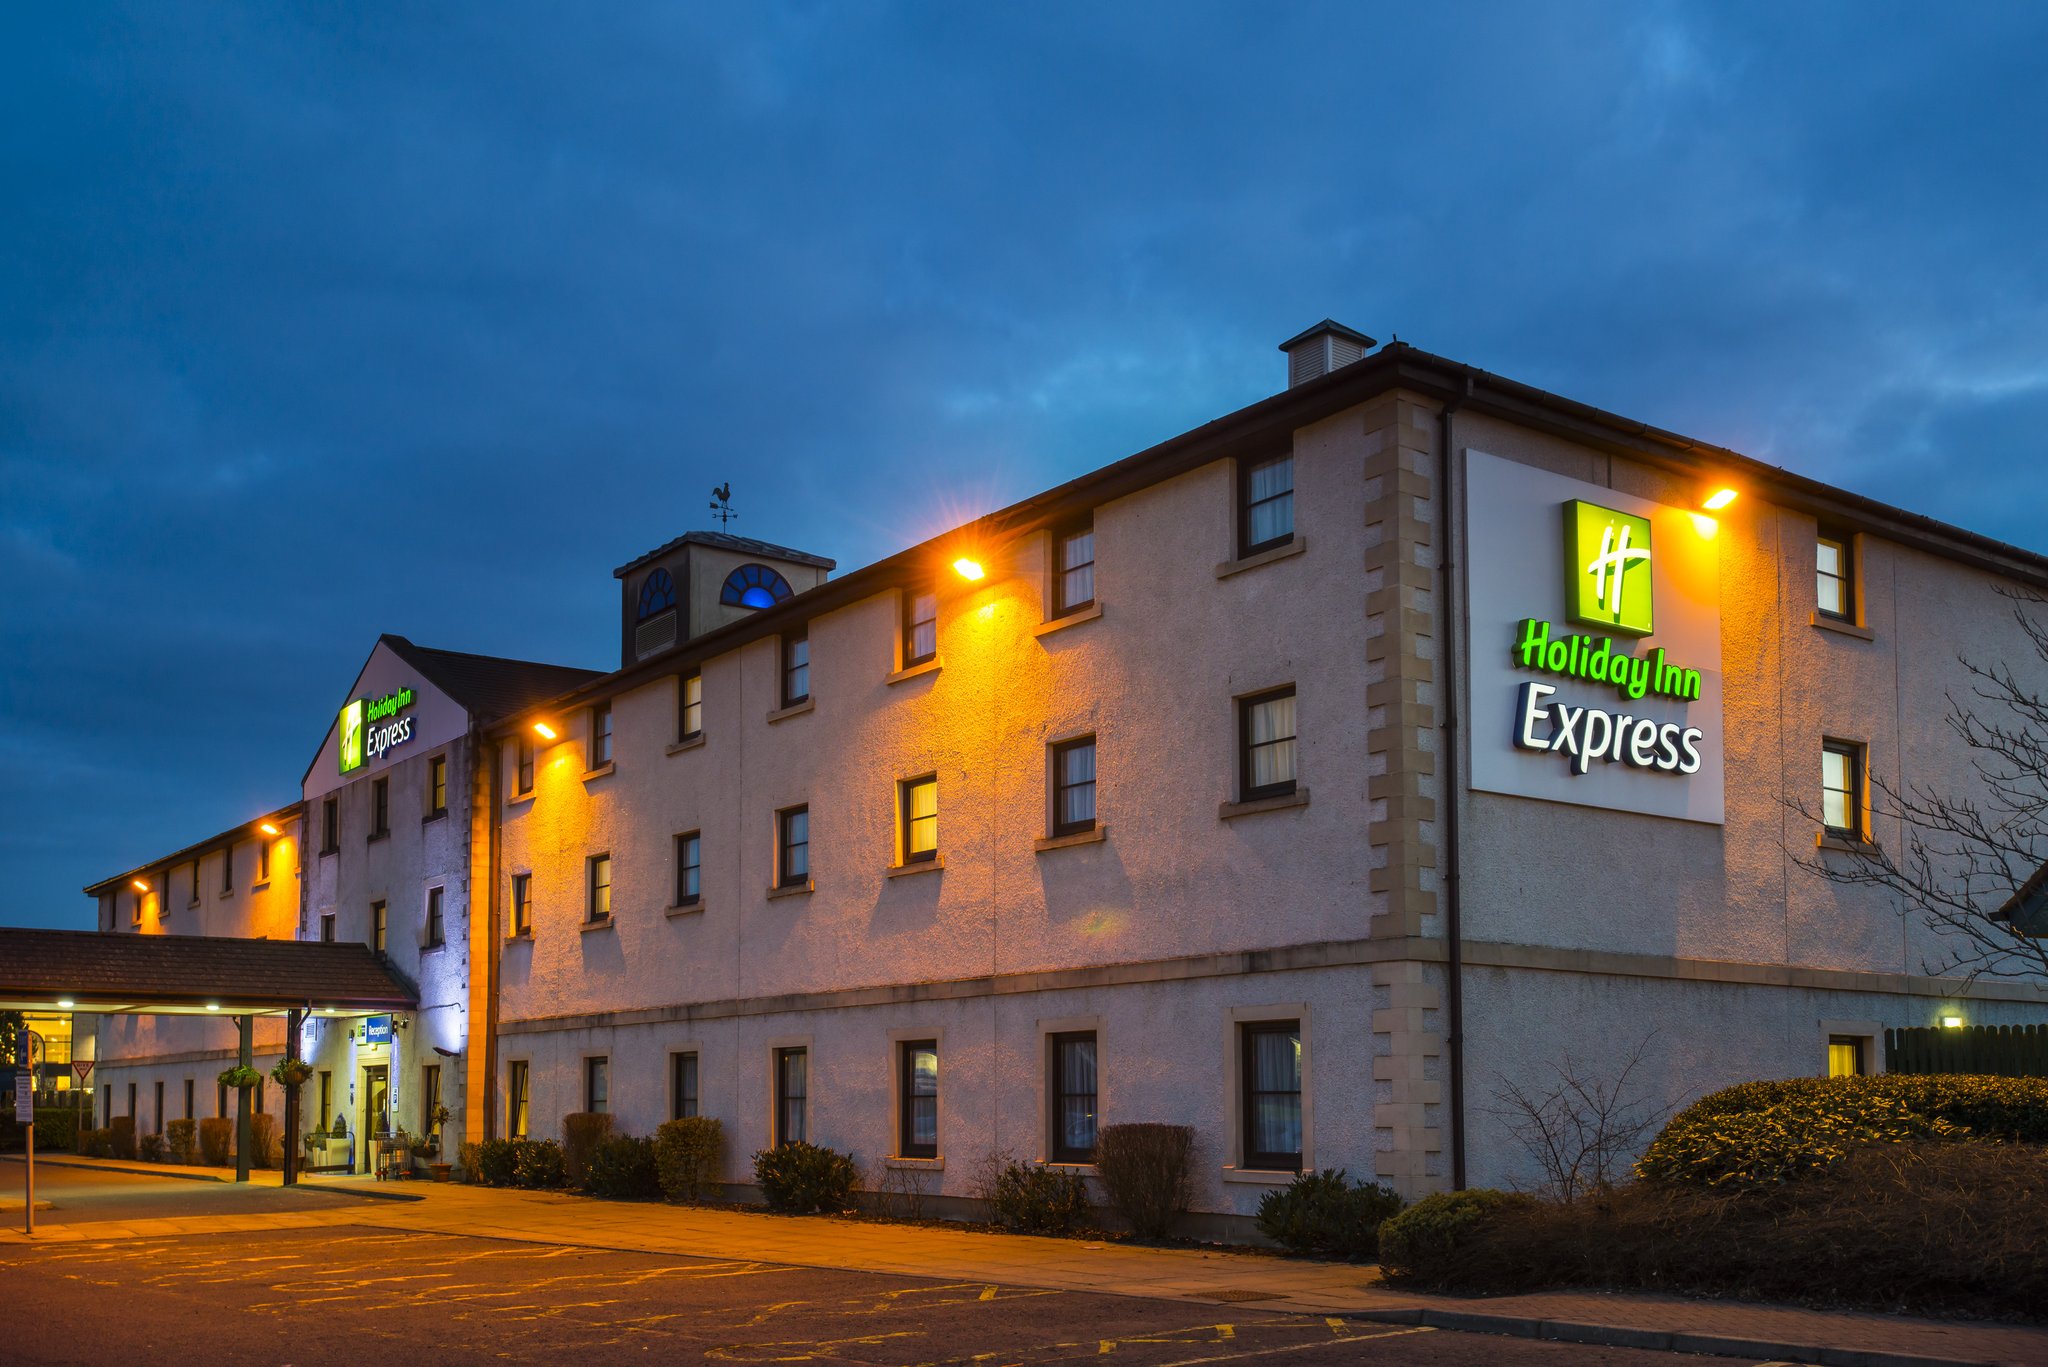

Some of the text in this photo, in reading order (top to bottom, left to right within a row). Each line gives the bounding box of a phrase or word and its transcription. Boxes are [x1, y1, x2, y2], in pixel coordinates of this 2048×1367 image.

[1520, 618, 1701, 700] Holiday Inn
[367, 687, 411, 723] Holiday Inn
[1522, 681, 1703, 774] Express
[366, 716, 411, 759] Express
